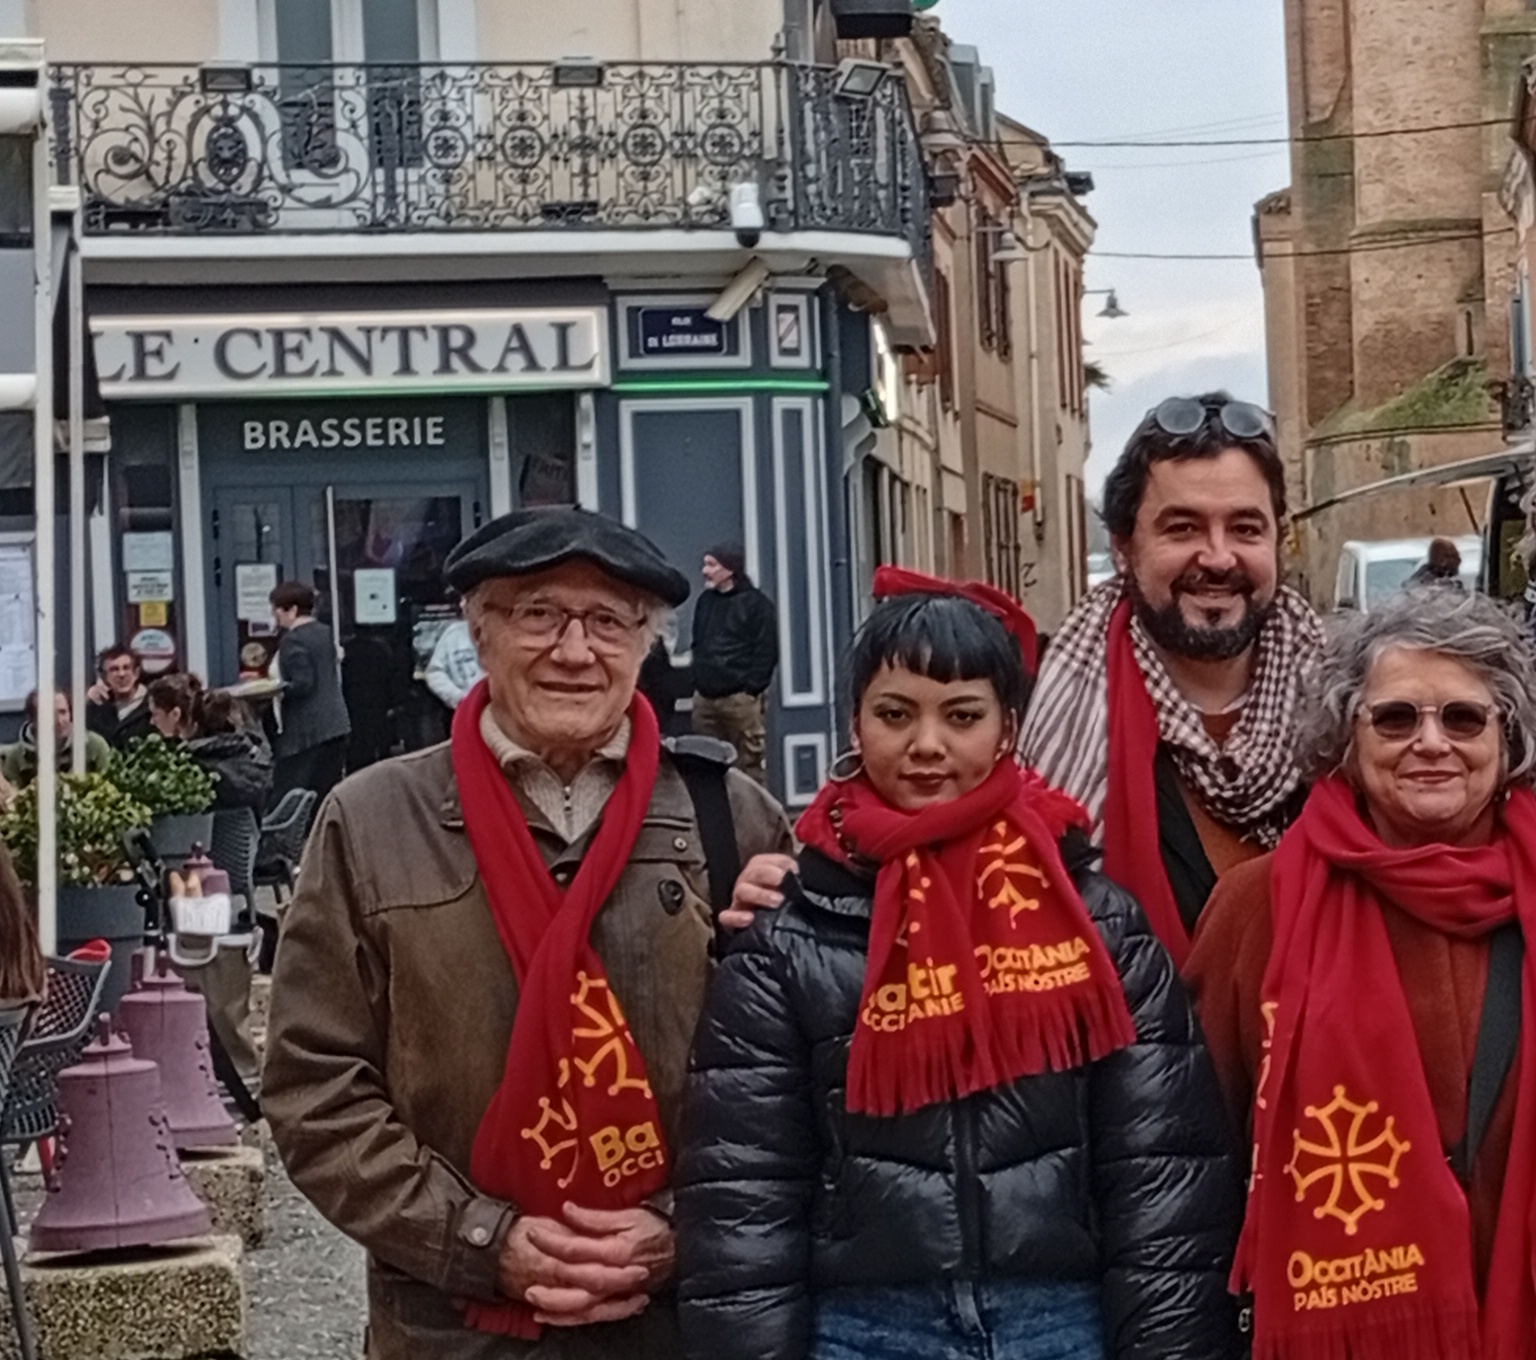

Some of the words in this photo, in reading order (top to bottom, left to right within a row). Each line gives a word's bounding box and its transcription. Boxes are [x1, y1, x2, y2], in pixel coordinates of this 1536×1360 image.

[212, 320, 598, 382] CENTRAL
[243, 416, 446, 451] BRASSERIE
[588, 1121, 660, 1172] Ba
[603, 1149, 665, 1188] OCCI
